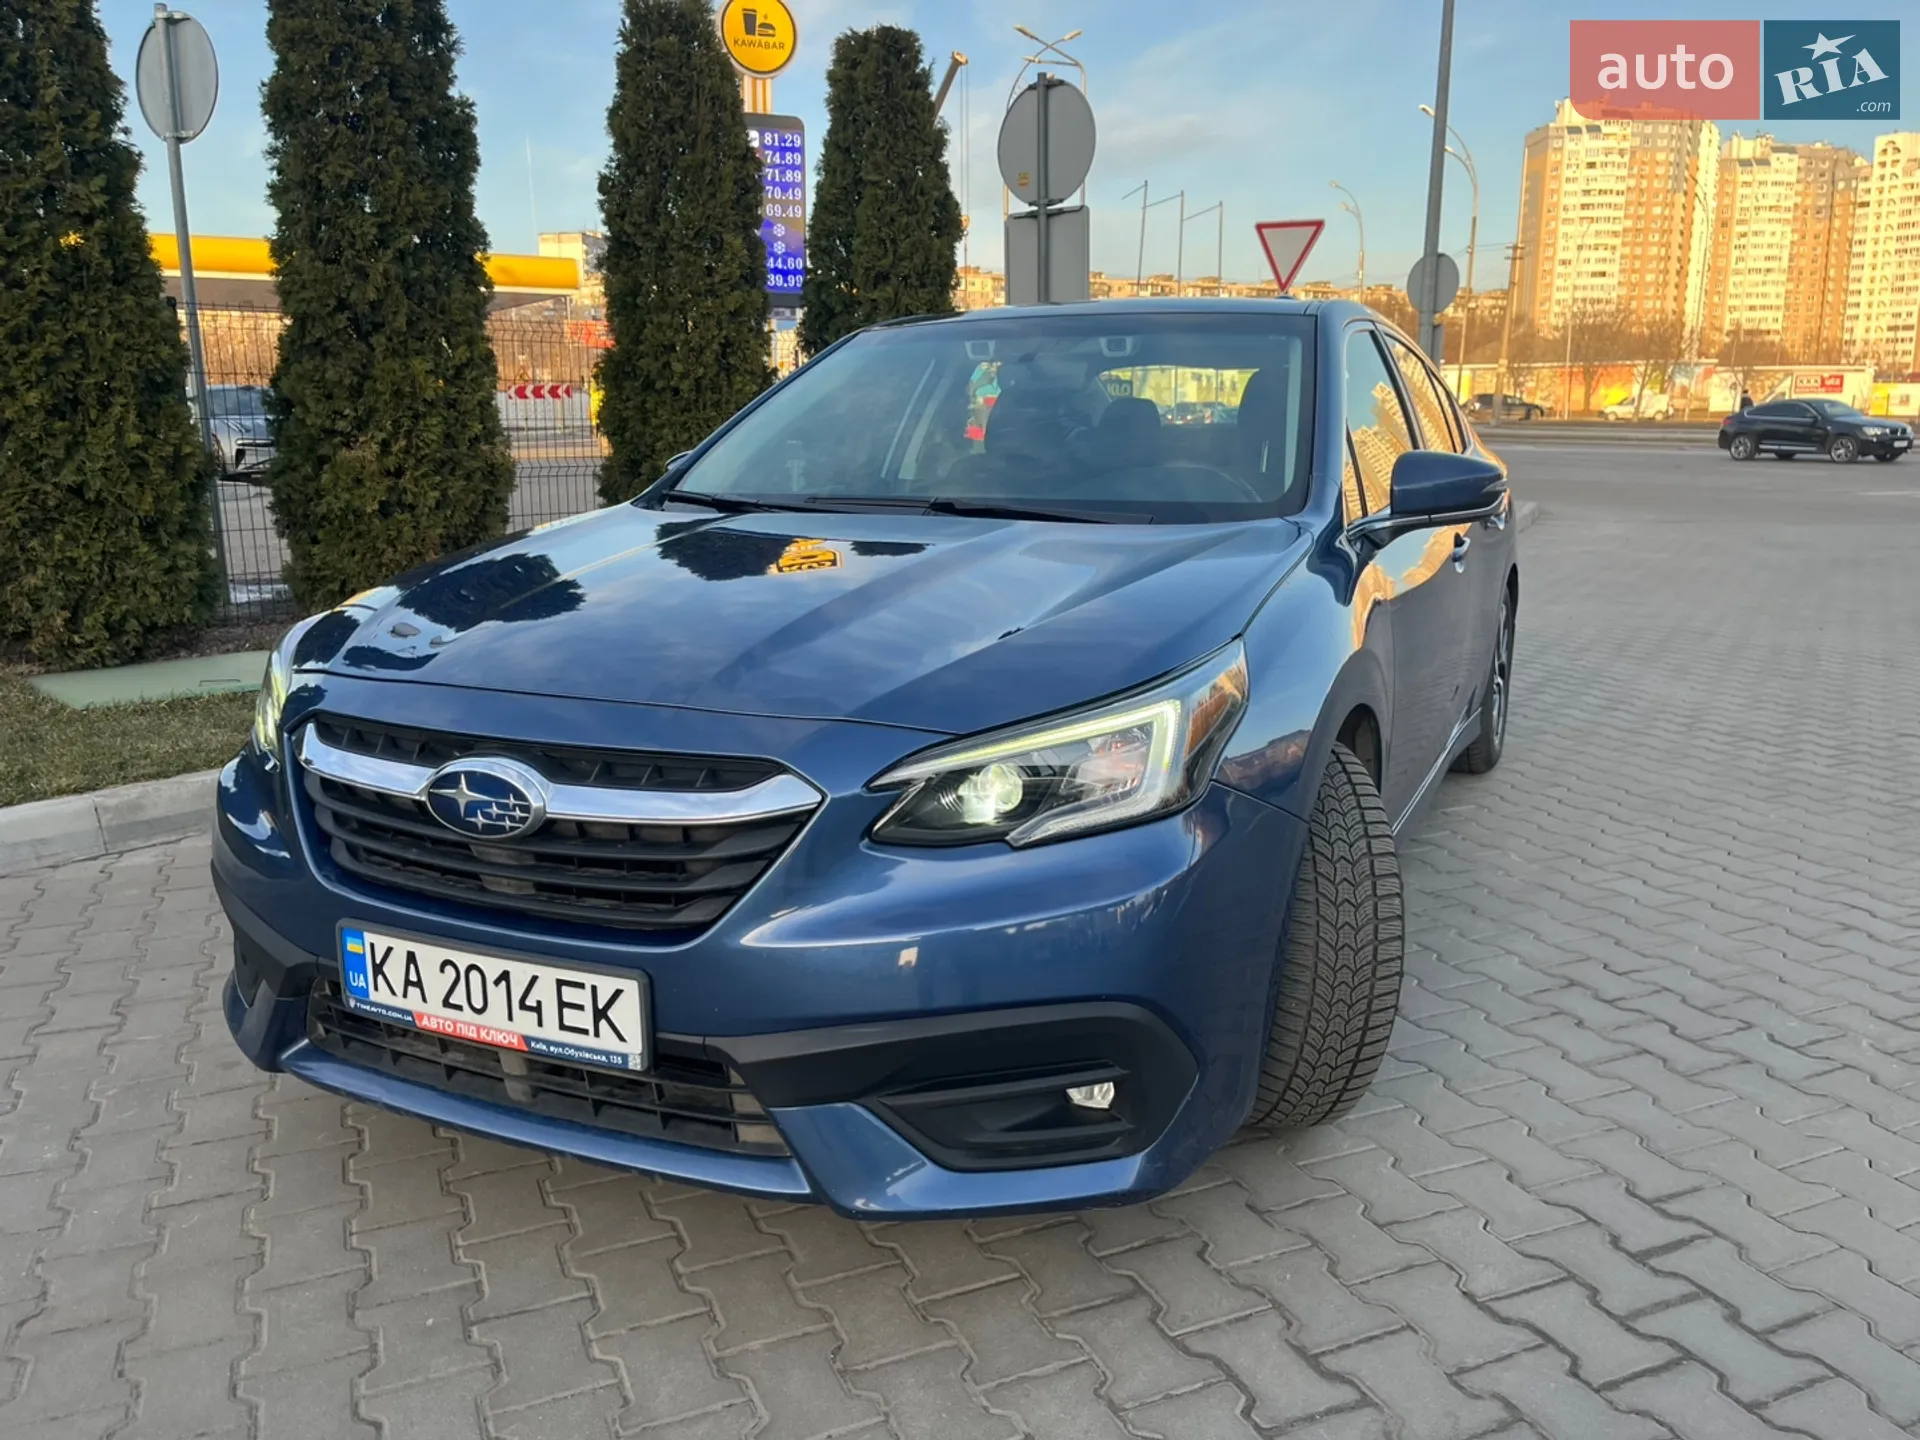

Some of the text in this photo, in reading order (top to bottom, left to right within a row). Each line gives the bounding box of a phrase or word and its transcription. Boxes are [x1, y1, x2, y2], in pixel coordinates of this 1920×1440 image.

[733, 38, 785, 50] KAWABAR
[764, 132, 801, 148] 81.29
[765, 150, 802, 165] 74.89
[765, 168, 802, 183] 71.89
[765, 185, 802, 200] 70.49
[766, 203, 802, 217] 69.49
[767, 257, 803, 270] 44.60
[767, 273, 803, 287] 39.99
[349, 973, 367, 989] UA
[369, 942, 628, 1043] KA 2014 EK
[422, 1015, 518, 1046] АВТО ПІД КЛЮЧ
